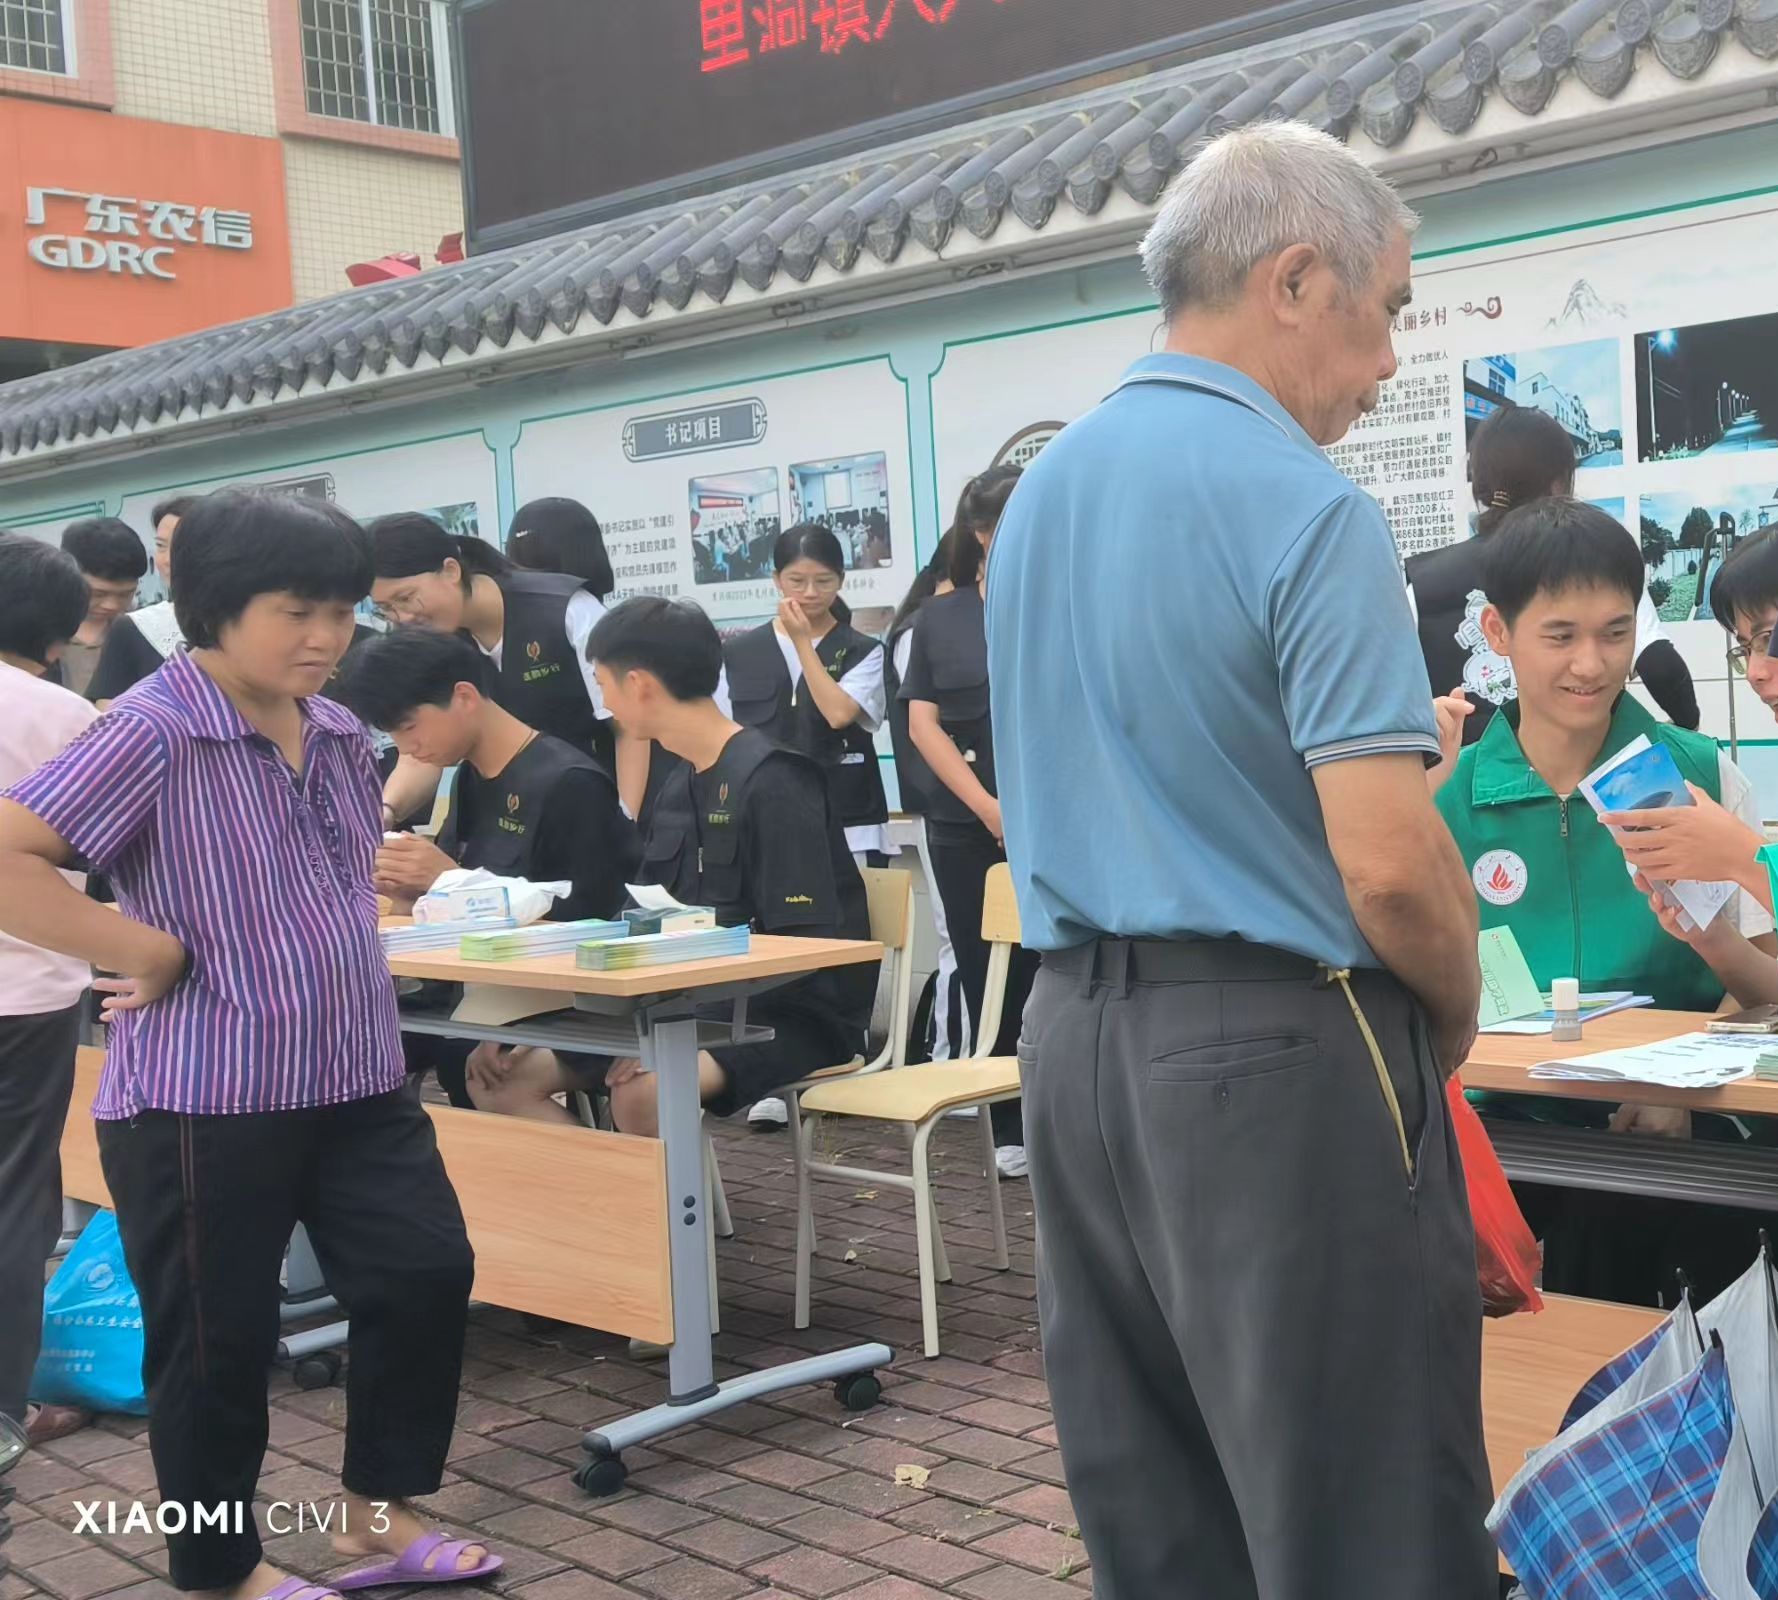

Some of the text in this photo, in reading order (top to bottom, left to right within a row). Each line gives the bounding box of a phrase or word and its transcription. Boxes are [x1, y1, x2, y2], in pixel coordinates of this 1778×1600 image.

[26, 186, 252, 249] 广东农信
[29, 234, 176, 279] GDRC
[664, 416, 722, 446] 书记项目
